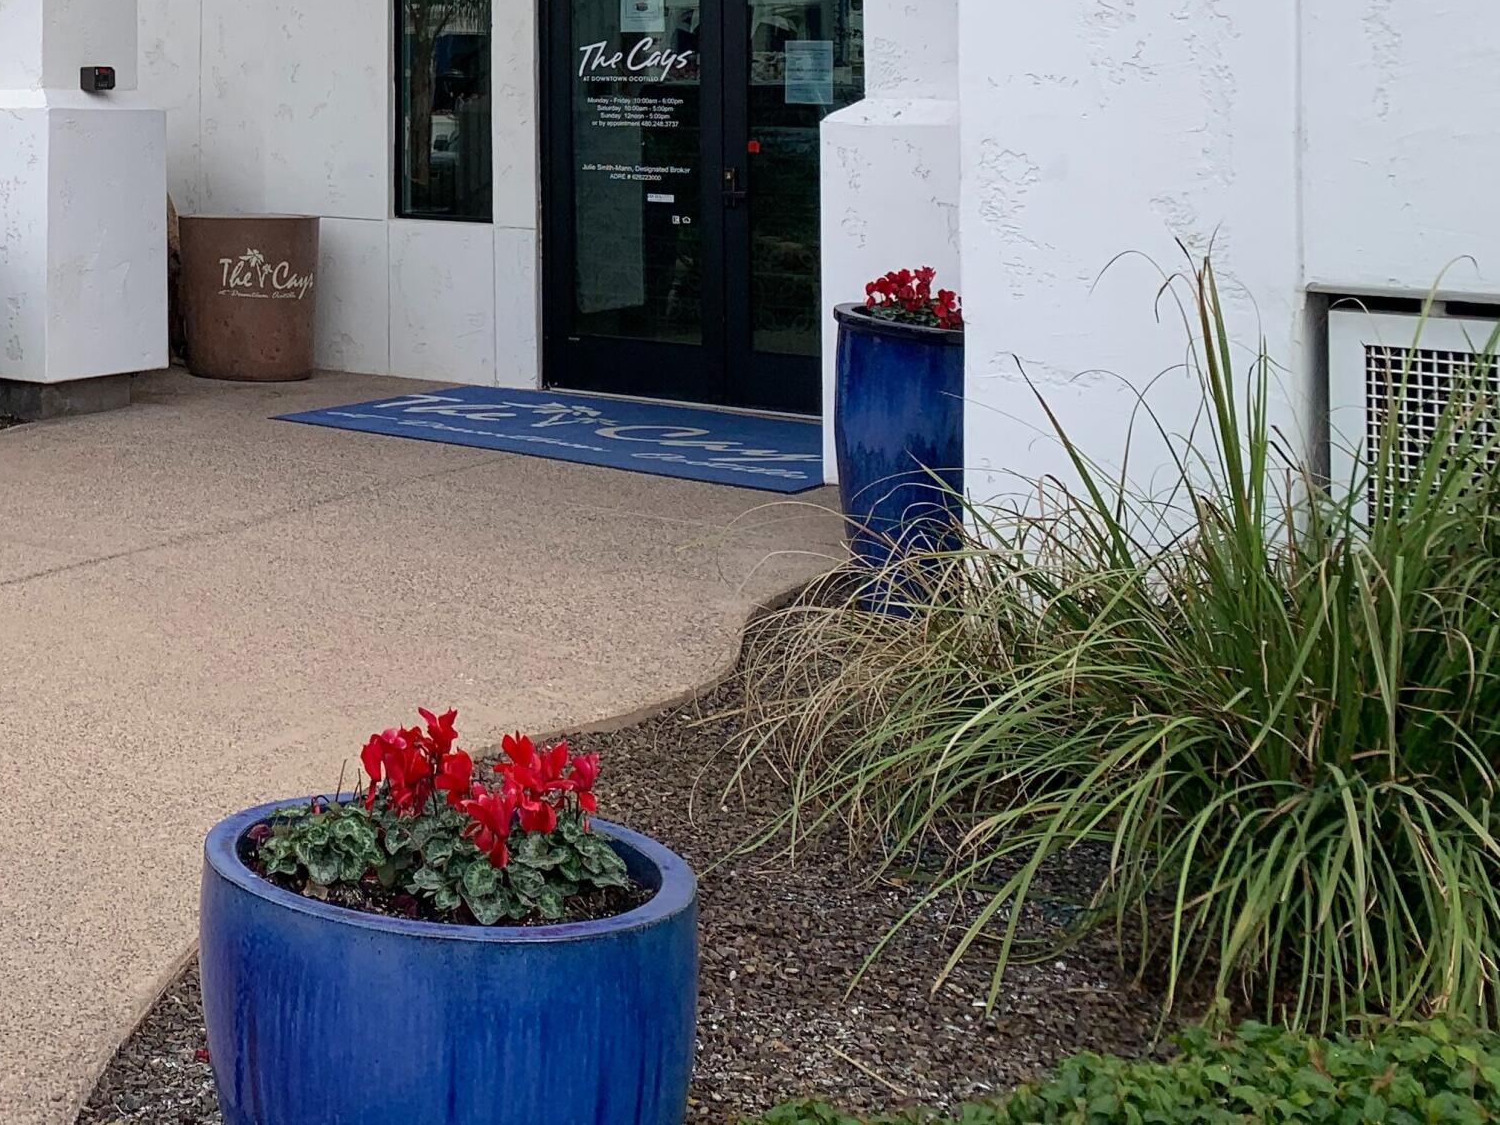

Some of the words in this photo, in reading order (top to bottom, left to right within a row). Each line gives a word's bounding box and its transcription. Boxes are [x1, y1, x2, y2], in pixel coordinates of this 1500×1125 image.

[579, 40, 623, 77] The
[627, 36, 692, 82] Cays
[587, 97, 609, 105] Monday
[613, 97, 631, 105] Friday
[219, 258, 253, 288] The
[373, 394, 517, 421] The
